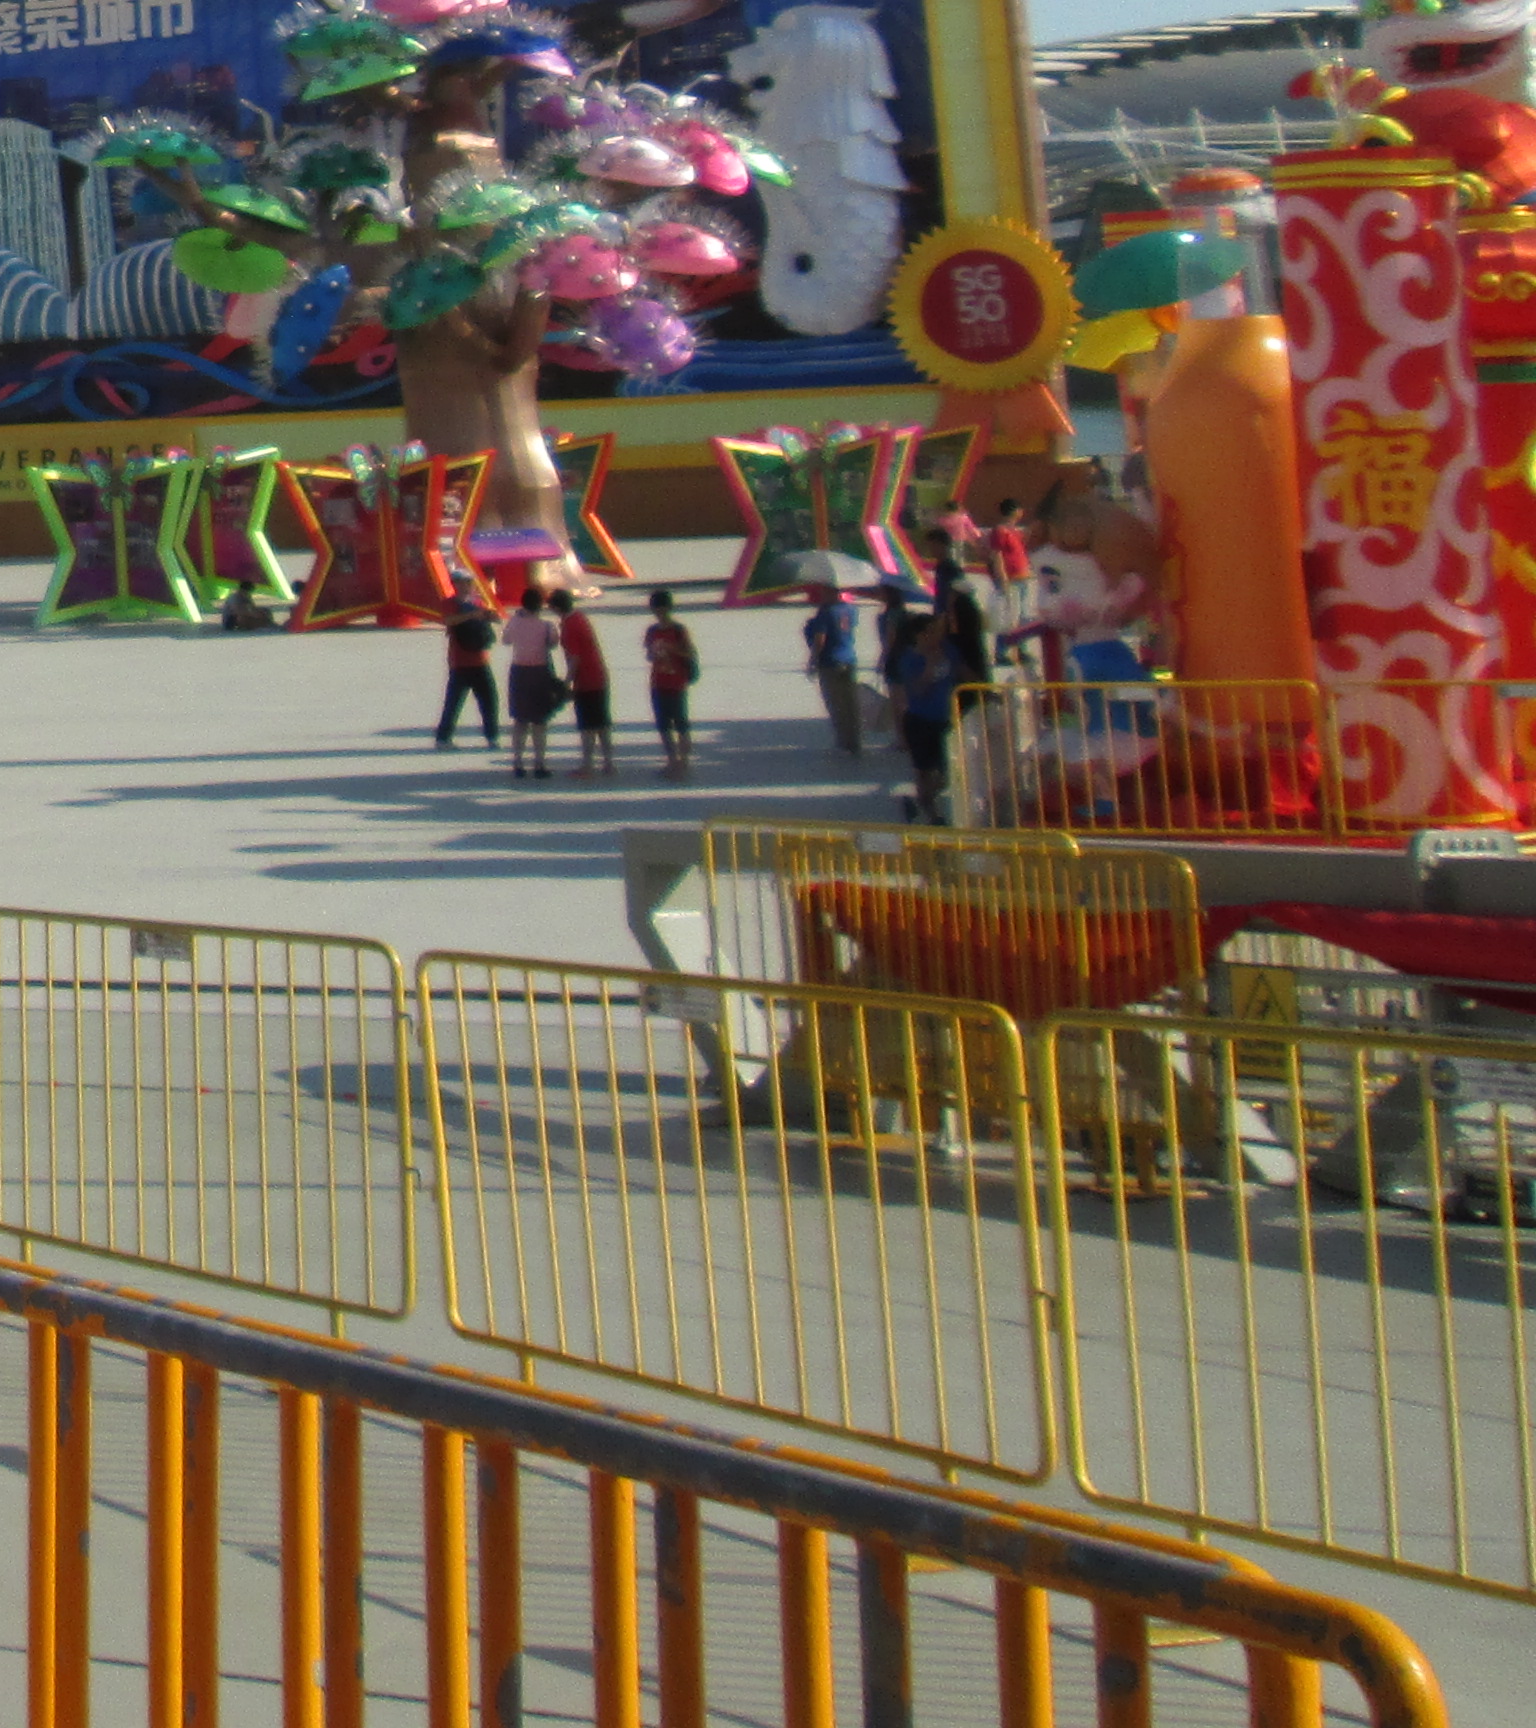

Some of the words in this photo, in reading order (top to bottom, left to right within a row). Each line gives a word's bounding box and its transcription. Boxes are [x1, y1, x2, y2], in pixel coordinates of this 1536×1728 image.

[951, 263, 1003, 293] SG
[958, 292, 1008, 325] 50
[1316, 407, 1439, 533] 福
